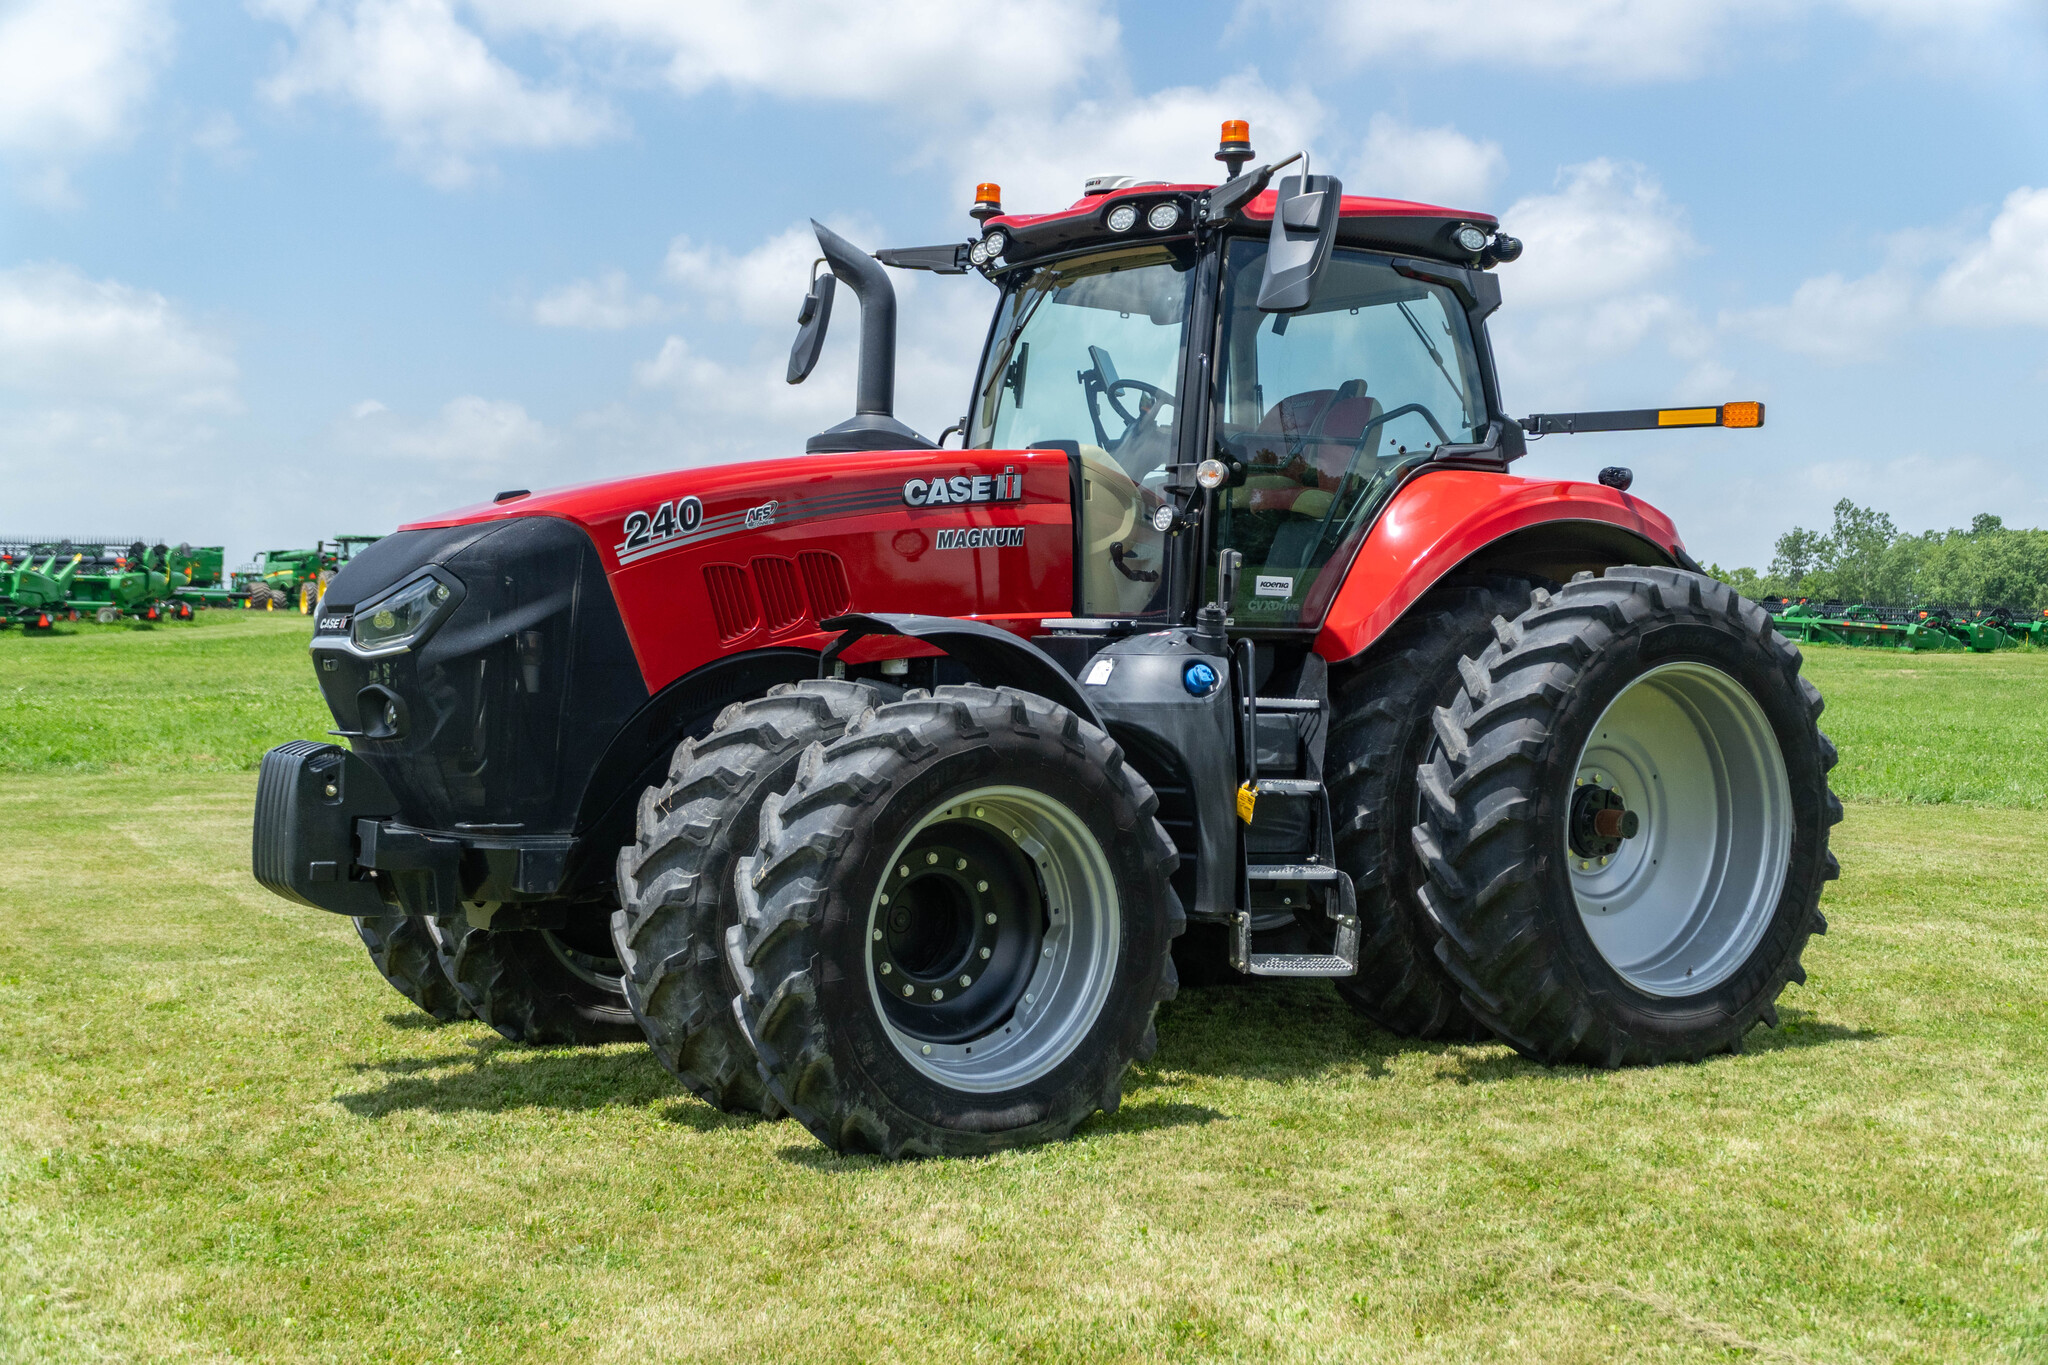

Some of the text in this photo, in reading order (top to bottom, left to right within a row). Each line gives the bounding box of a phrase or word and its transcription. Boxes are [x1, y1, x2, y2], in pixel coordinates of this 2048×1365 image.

[903, 475, 993, 507] CASE
[623, 495, 703, 552] 240
[745, 504, 772, 523] AFS
[936, 527, 1025, 550] MAGNUM
[1248, 600, 1300, 611] CVXDrive
[320, 617, 340, 629] CASE
